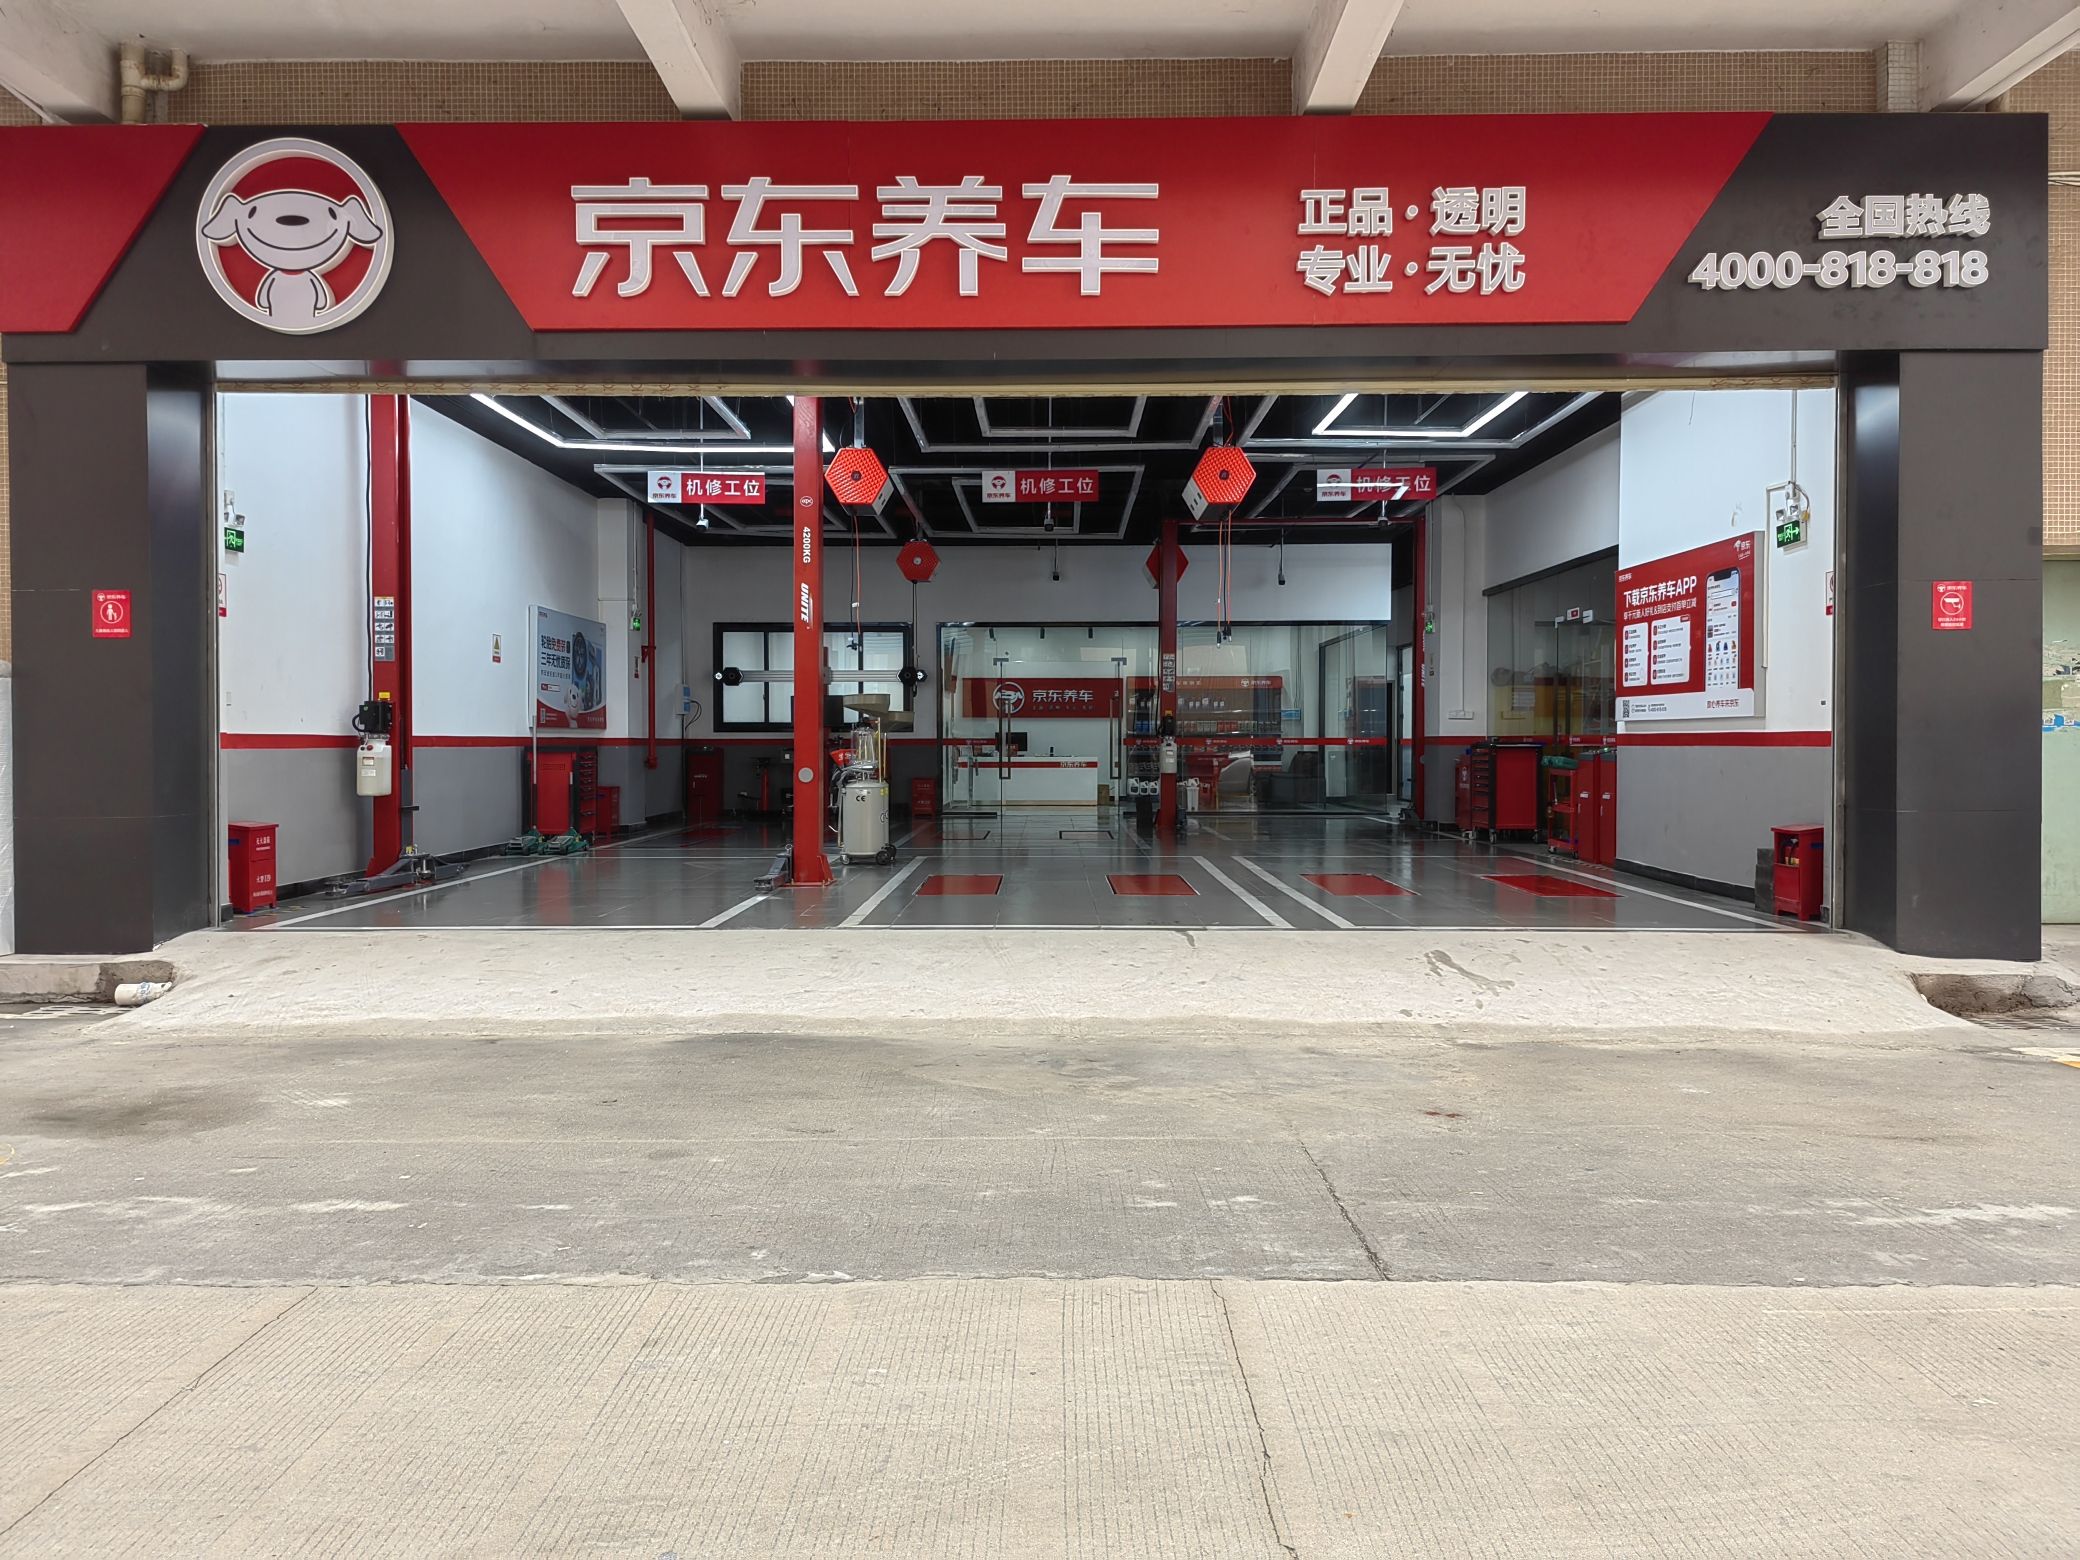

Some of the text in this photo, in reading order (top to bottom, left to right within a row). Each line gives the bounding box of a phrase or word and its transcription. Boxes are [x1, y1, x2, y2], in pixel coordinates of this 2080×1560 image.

[1297, 186, 1527, 237] 正品·透明
[1816, 193, 1991, 240] 全国热线
[571, 175, 1160, 297] 京东养车
[1296, 242, 1526, 297] 专业·无忧
[1687, 250, 1989, 290] 4000-818-818
[686, 479, 760, 497] 机修工位
[1020, 477, 1094, 495] 机修工位
[1356, 475, 1431, 493] 机修工位
[802, 526, 811, 563] 4200KG
[800, 582, 809, 623] UNITE
[1623, 575, 1697, 608] 下载京东养车APP
[1032, 689, 1094, 703] 京东养车
